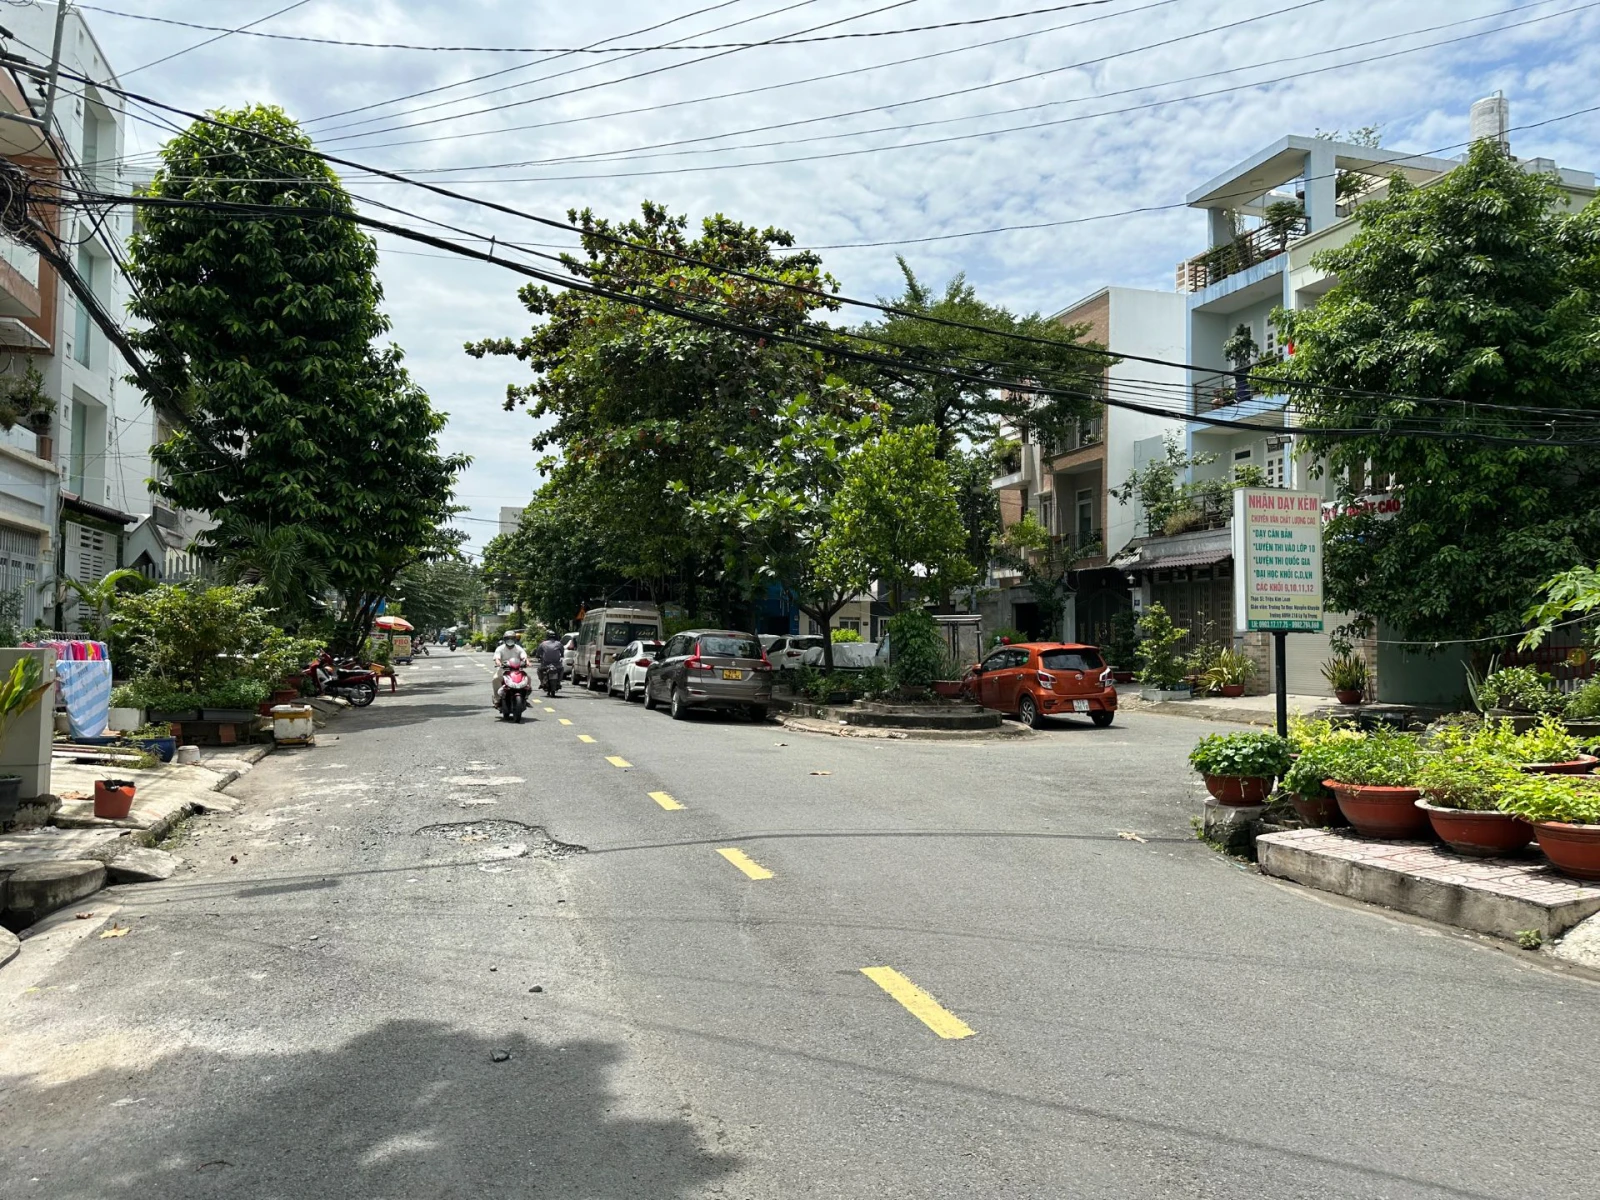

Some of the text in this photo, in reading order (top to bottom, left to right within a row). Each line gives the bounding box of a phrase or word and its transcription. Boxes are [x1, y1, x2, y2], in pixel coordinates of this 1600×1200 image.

[1248, 492, 1274, 512] NHẬN
[1278, 496, 1294, 512] DẠY
[1378, 500, 1400, 514] CAO
[1252, 514, 1268, 523] CHUYÊN
[1284, 543, 1295, 552] VÀO
[1297, 543, 1307, 552] LỚP
[1285, 555, 1299, 566] QUỐC
[1267, 570, 1278, 580] HỌC
[1280, 569, 1293, 578] KHỐI
[1256, 582, 1268, 591] CÁC
[1270, 582, 1283, 591] KHỐI
